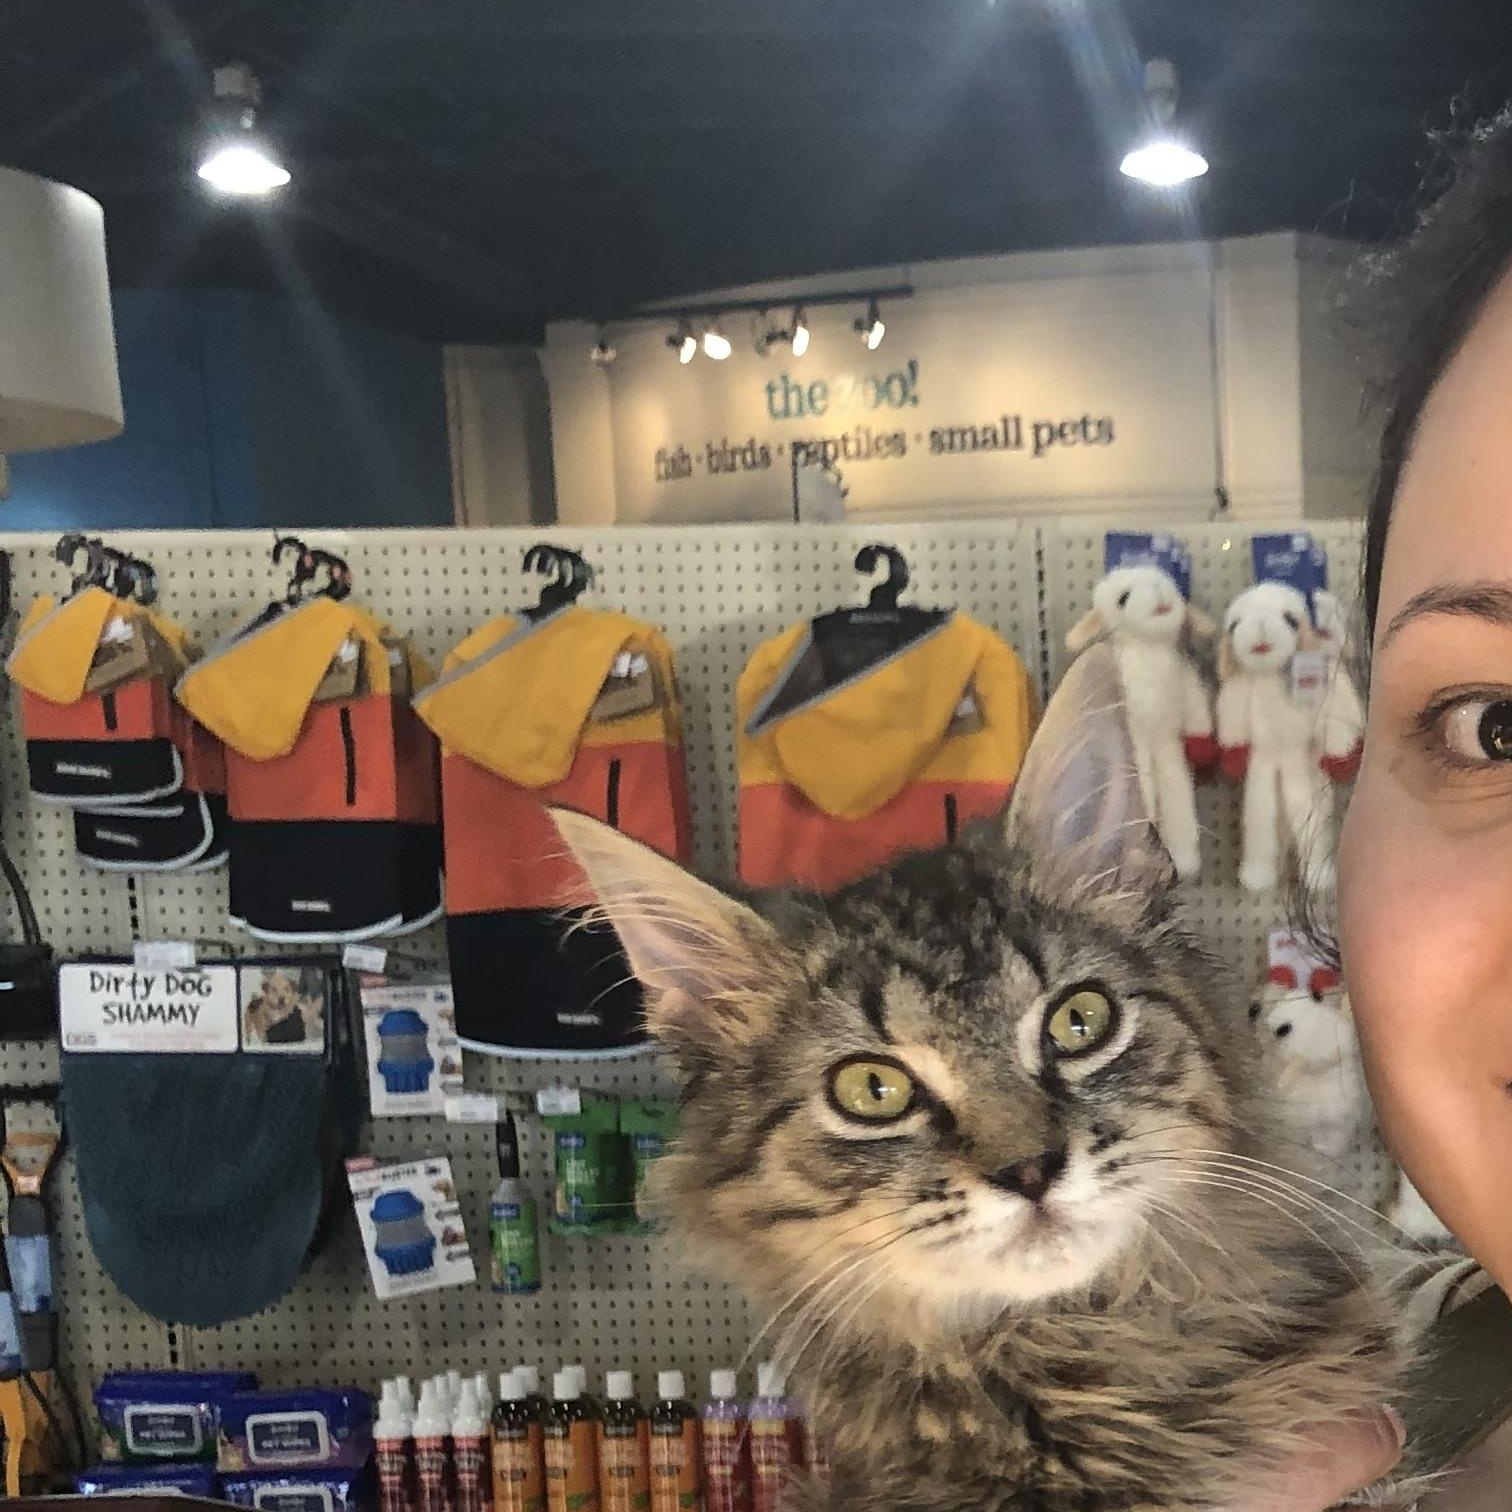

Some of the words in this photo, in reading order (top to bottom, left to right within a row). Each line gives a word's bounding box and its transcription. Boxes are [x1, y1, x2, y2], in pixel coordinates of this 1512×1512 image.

[764, 371, 829, 420] the
[836, 359, 920, 413] oo!
[654, 444, 693, 482] fish
[706, 437, 772, 475] birds
[928, 413, 1023, 455] small
[1031, 414, 1116, 458] pets
[89, 969, 157, 1001] Dirty
[103, 1002, 201, 1028] SHAMMY
